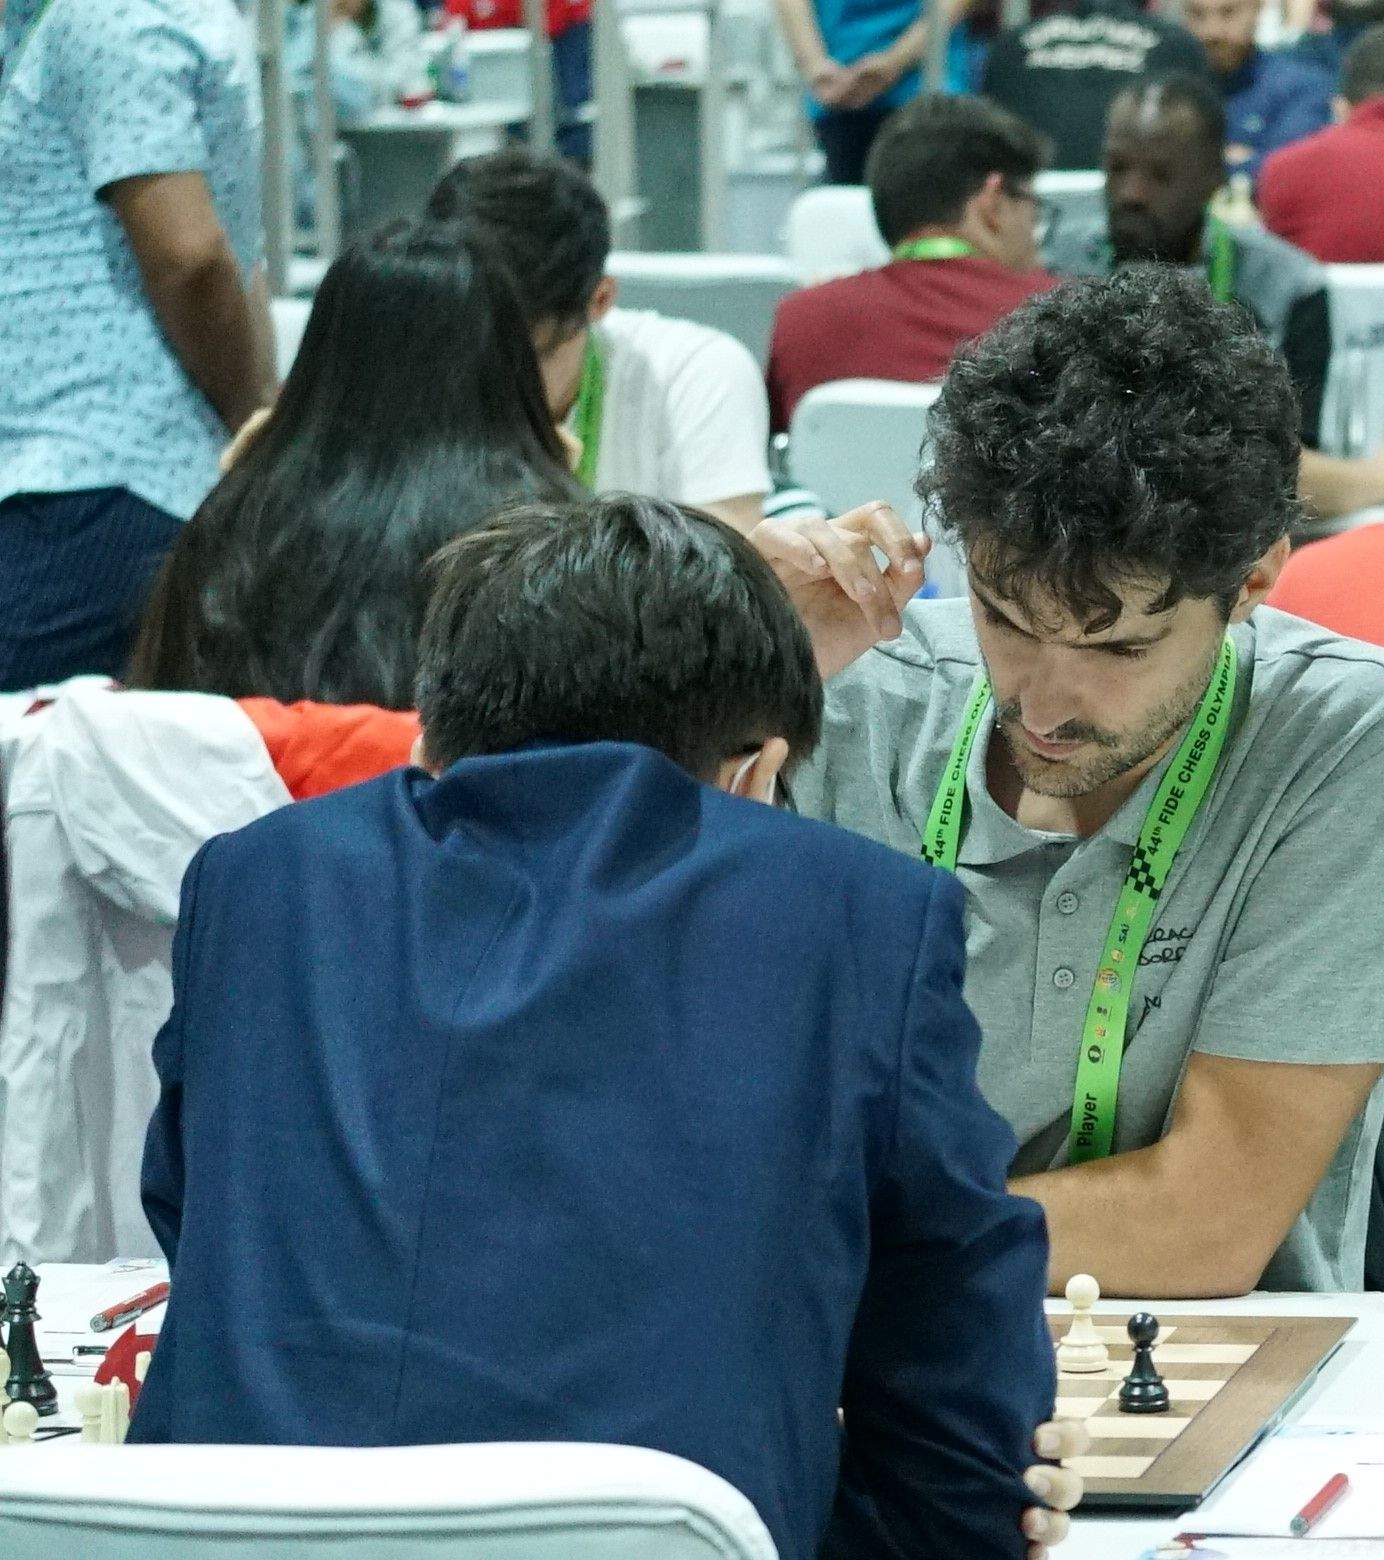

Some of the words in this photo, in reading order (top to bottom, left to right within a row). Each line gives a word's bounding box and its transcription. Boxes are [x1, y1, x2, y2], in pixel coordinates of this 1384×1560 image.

[934, 828, 946, 859] 44th
[940, 787, 956, 826] FIDE
[952, 725, 972, 781] CHESS
[1146, 826, 1163, 856] 44th
[1158, 786, 1185, 825] FIDE
[1178, 727, 1211, 785] CHESS
[1206, 642, 1231, 727] OLYMPIAD
[1076, 1093, 1099, 1146] Player
